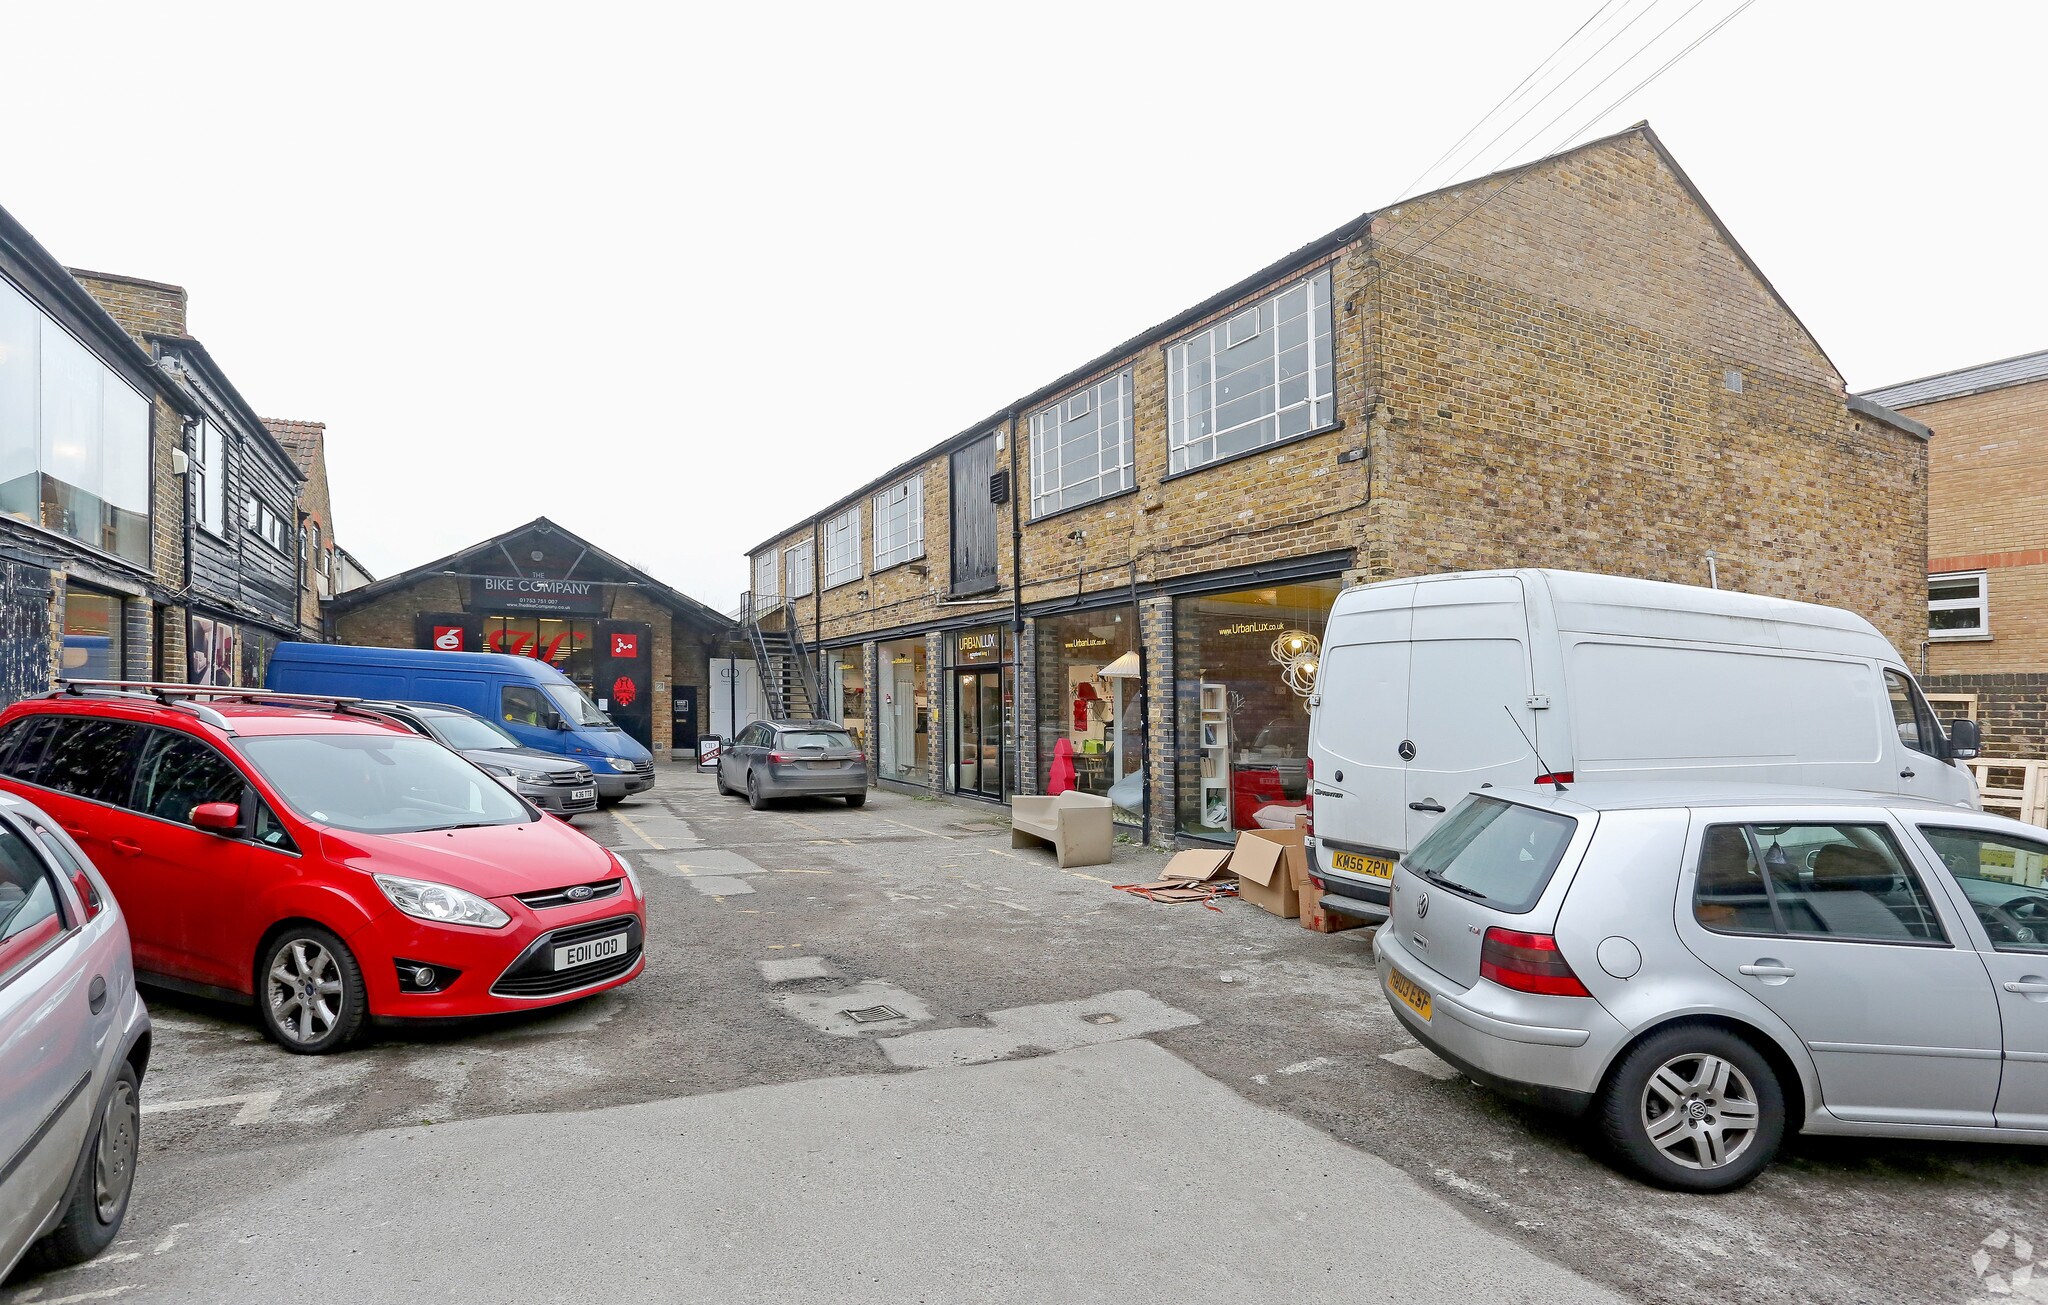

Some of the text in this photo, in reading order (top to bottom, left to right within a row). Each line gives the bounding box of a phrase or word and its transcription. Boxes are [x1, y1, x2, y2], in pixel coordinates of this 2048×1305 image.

[532, 571, 545, 579] THE
[485, 578, 591, 595] BIKE COMPANY
[506, 602, 571, 610] www.TheBikeCompany.co.uk
[1219, 622, 1285, 635] www.UrbanLux.co.uk
[958, 633, 995, 651] URBANLUX
[703, 750, 719, 760] SALE
[1336, 853, 1389, 877] KM56 ZPN
